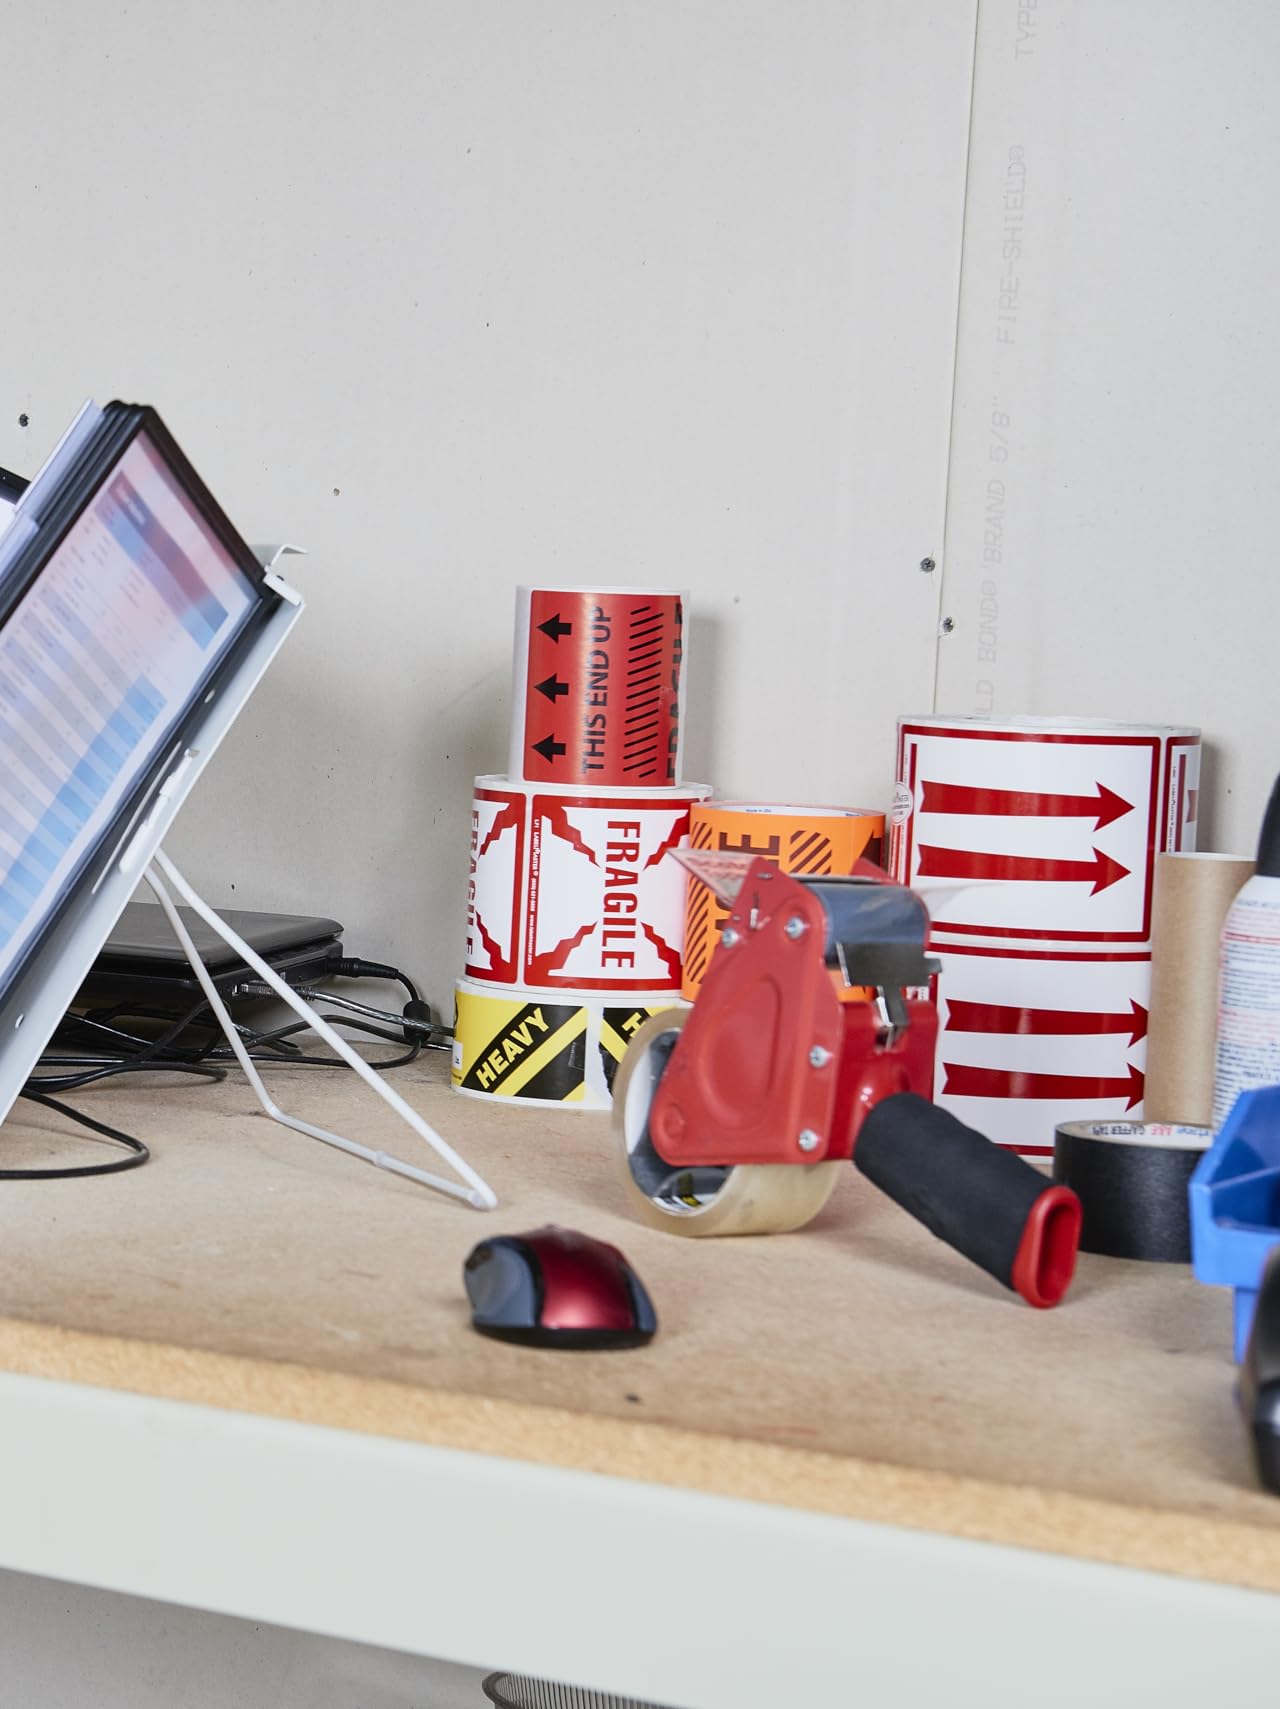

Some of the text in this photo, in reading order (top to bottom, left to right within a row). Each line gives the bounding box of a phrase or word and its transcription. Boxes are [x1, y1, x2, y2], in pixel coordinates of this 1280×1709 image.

[983, 479, 1006, 565] BRAND
[580, 605, 613, 775] THIS END UP
[601, 820, 641, 969] FRAGILE
[475, 1007, 550, 1089] HEAVY
